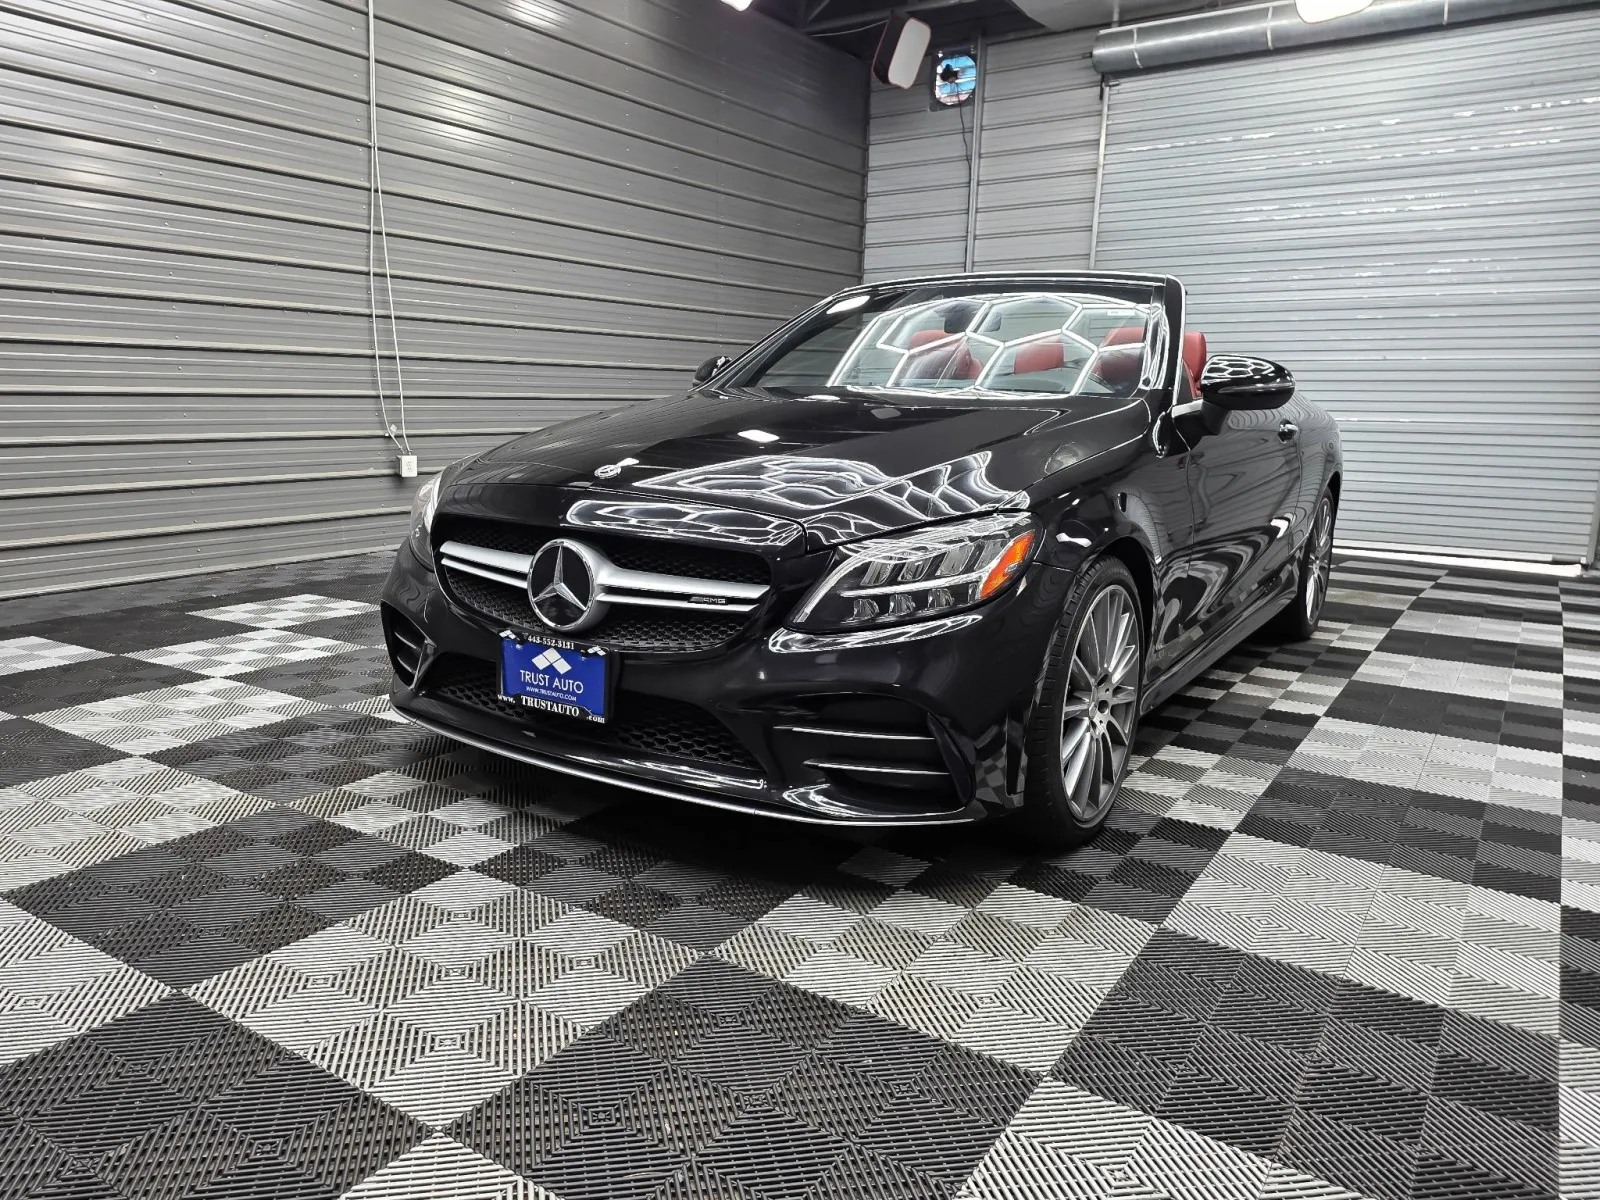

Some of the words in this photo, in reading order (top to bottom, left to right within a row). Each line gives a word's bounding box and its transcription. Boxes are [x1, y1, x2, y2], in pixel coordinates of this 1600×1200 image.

[528, 635, 575, 650] 443-552-3131
[520, 670, 550, 686] TRUST
[553, 677, 584, 694] AUTO
[526, 686, 577, 702] WWW.TRUSTAUTO.COM
[497, 694, 516, 704] www.
[521, 695, 579, 717] TRUSTAUTO
[586, 715, 605, 724] .com
